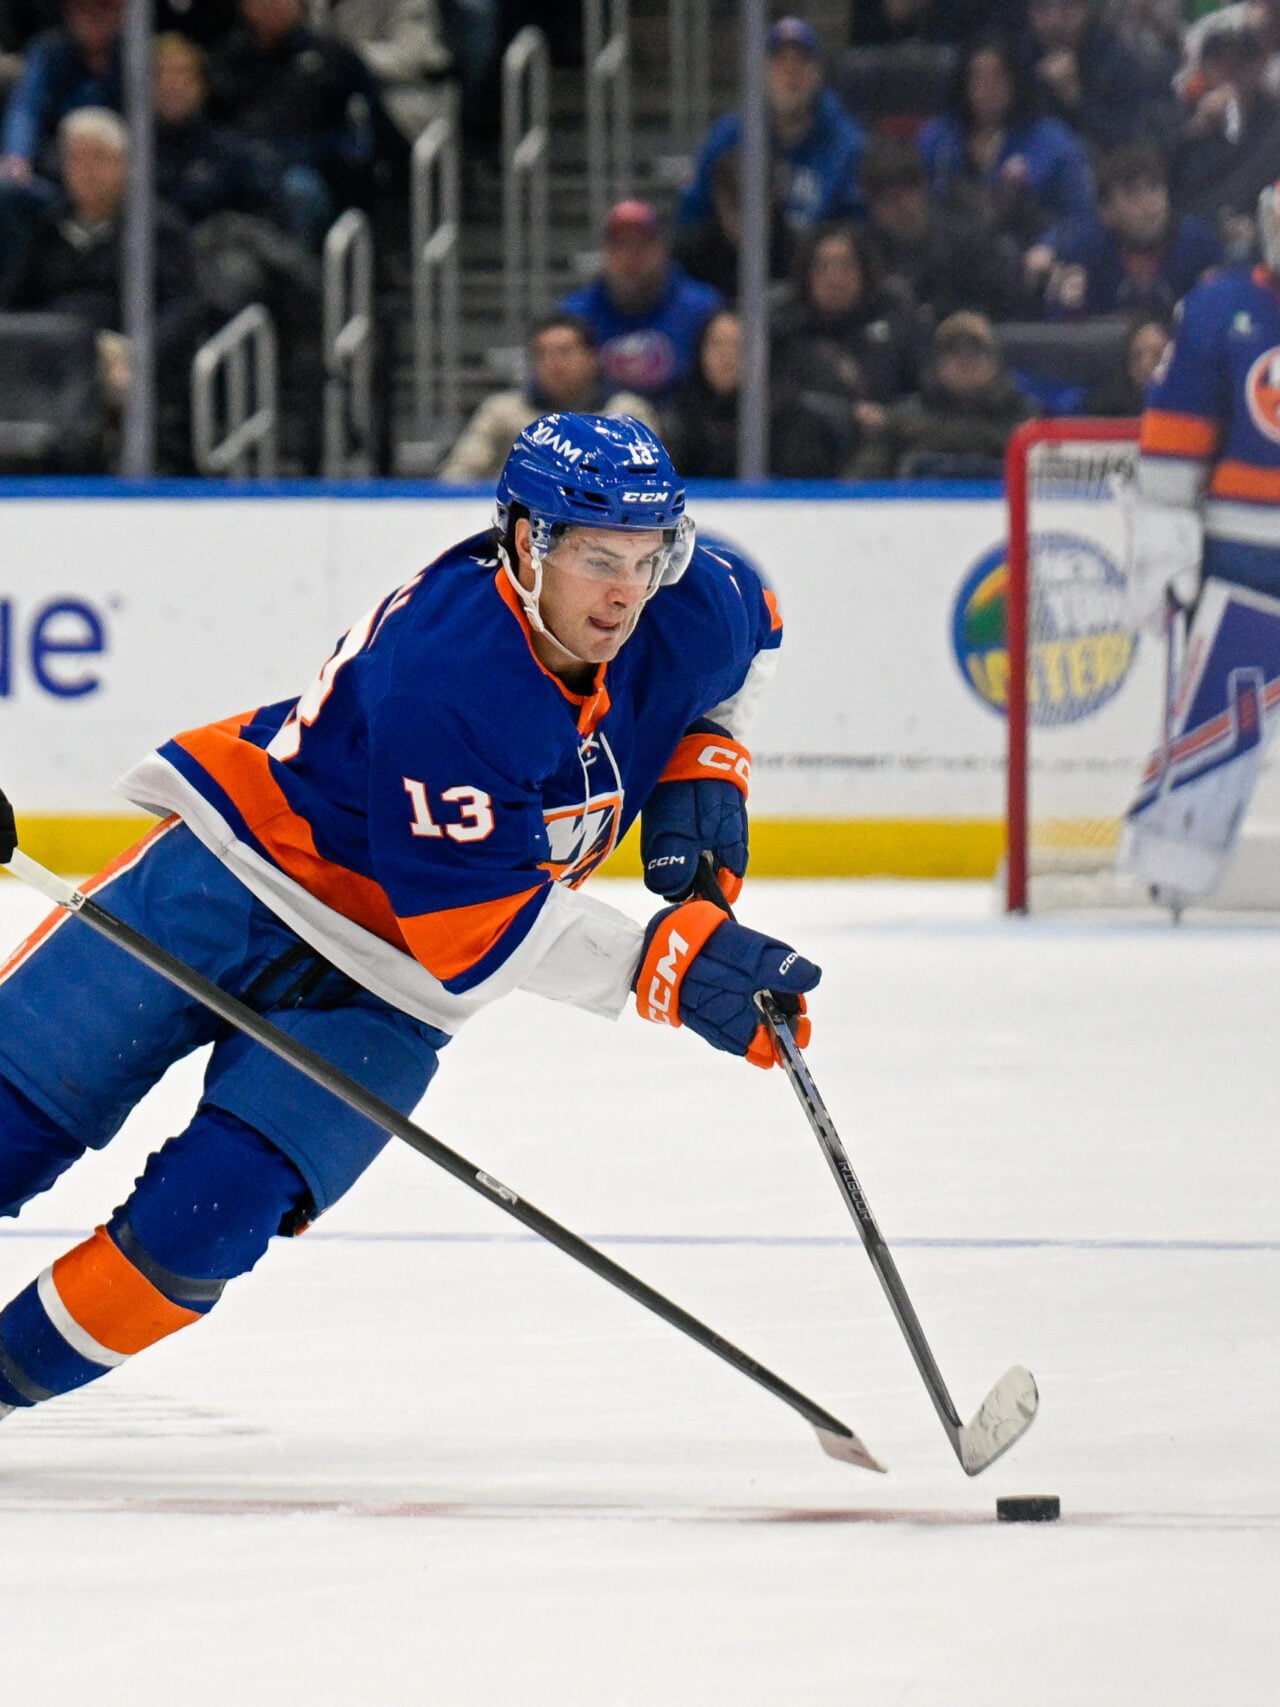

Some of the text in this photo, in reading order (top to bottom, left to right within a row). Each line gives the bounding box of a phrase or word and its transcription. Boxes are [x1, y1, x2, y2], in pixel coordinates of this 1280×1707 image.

[622, 491, 669, 503] CCM
[402, 776, 496, 843] 13
[647, 855, 686, 871] CCM
